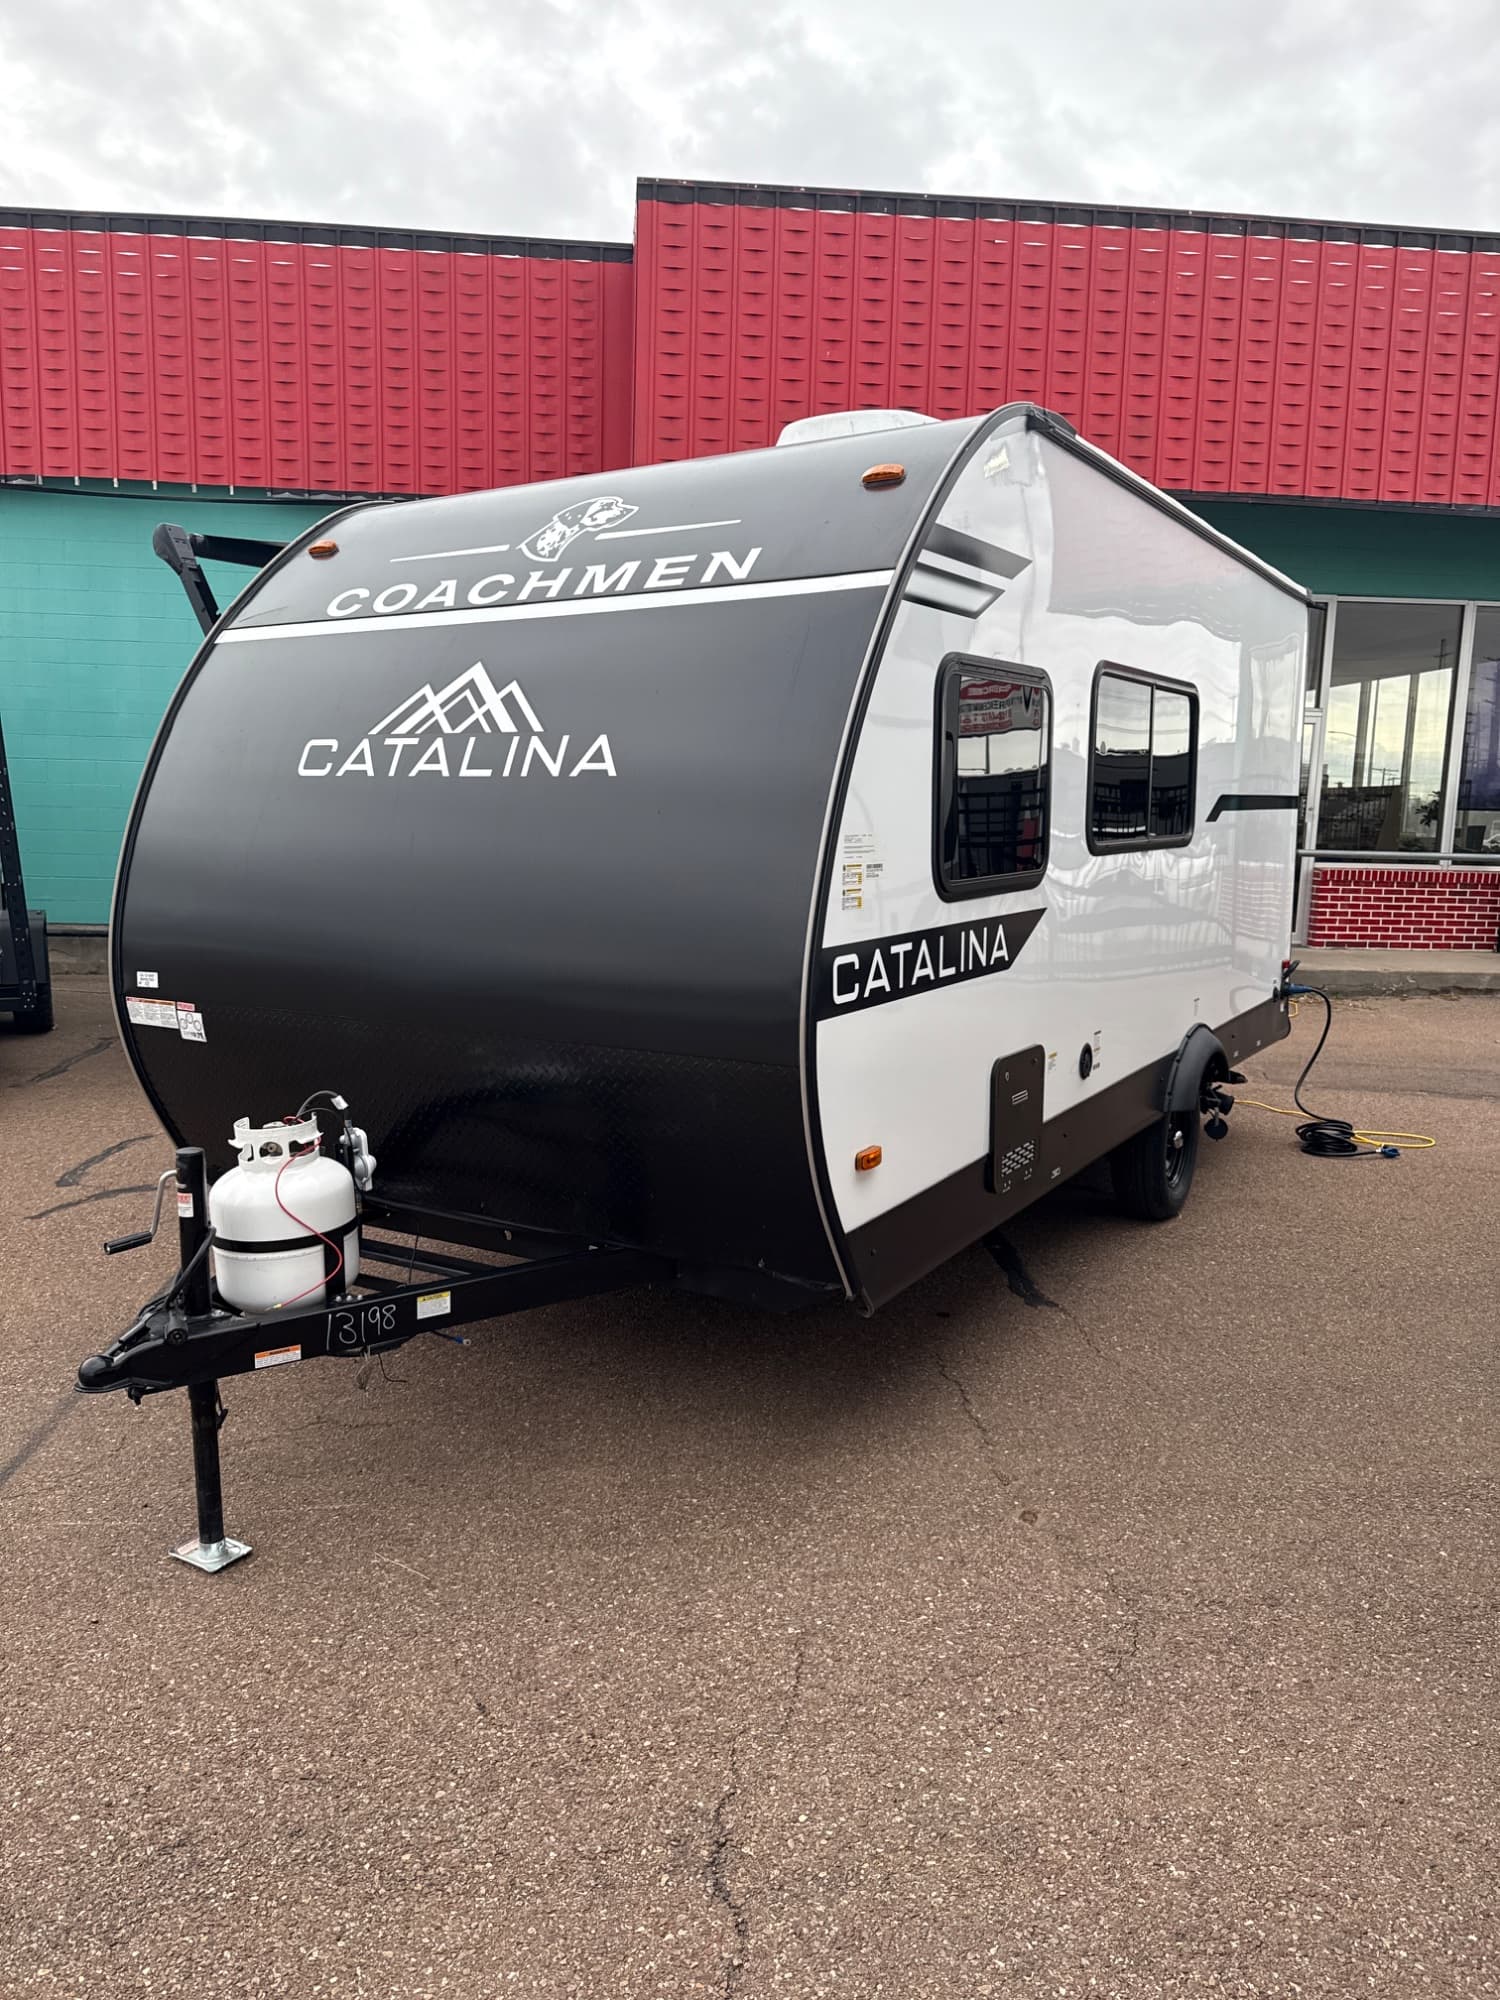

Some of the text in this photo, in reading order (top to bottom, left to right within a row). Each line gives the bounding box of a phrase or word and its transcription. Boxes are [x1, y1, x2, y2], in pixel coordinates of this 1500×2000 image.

[326, 547, 763, 618] COACHMEN
[298, 734, 617, 777] CATALINA
[832, 923, 1009, 1005] CATALINA
[325, 1303, 397, 1352] 13198
